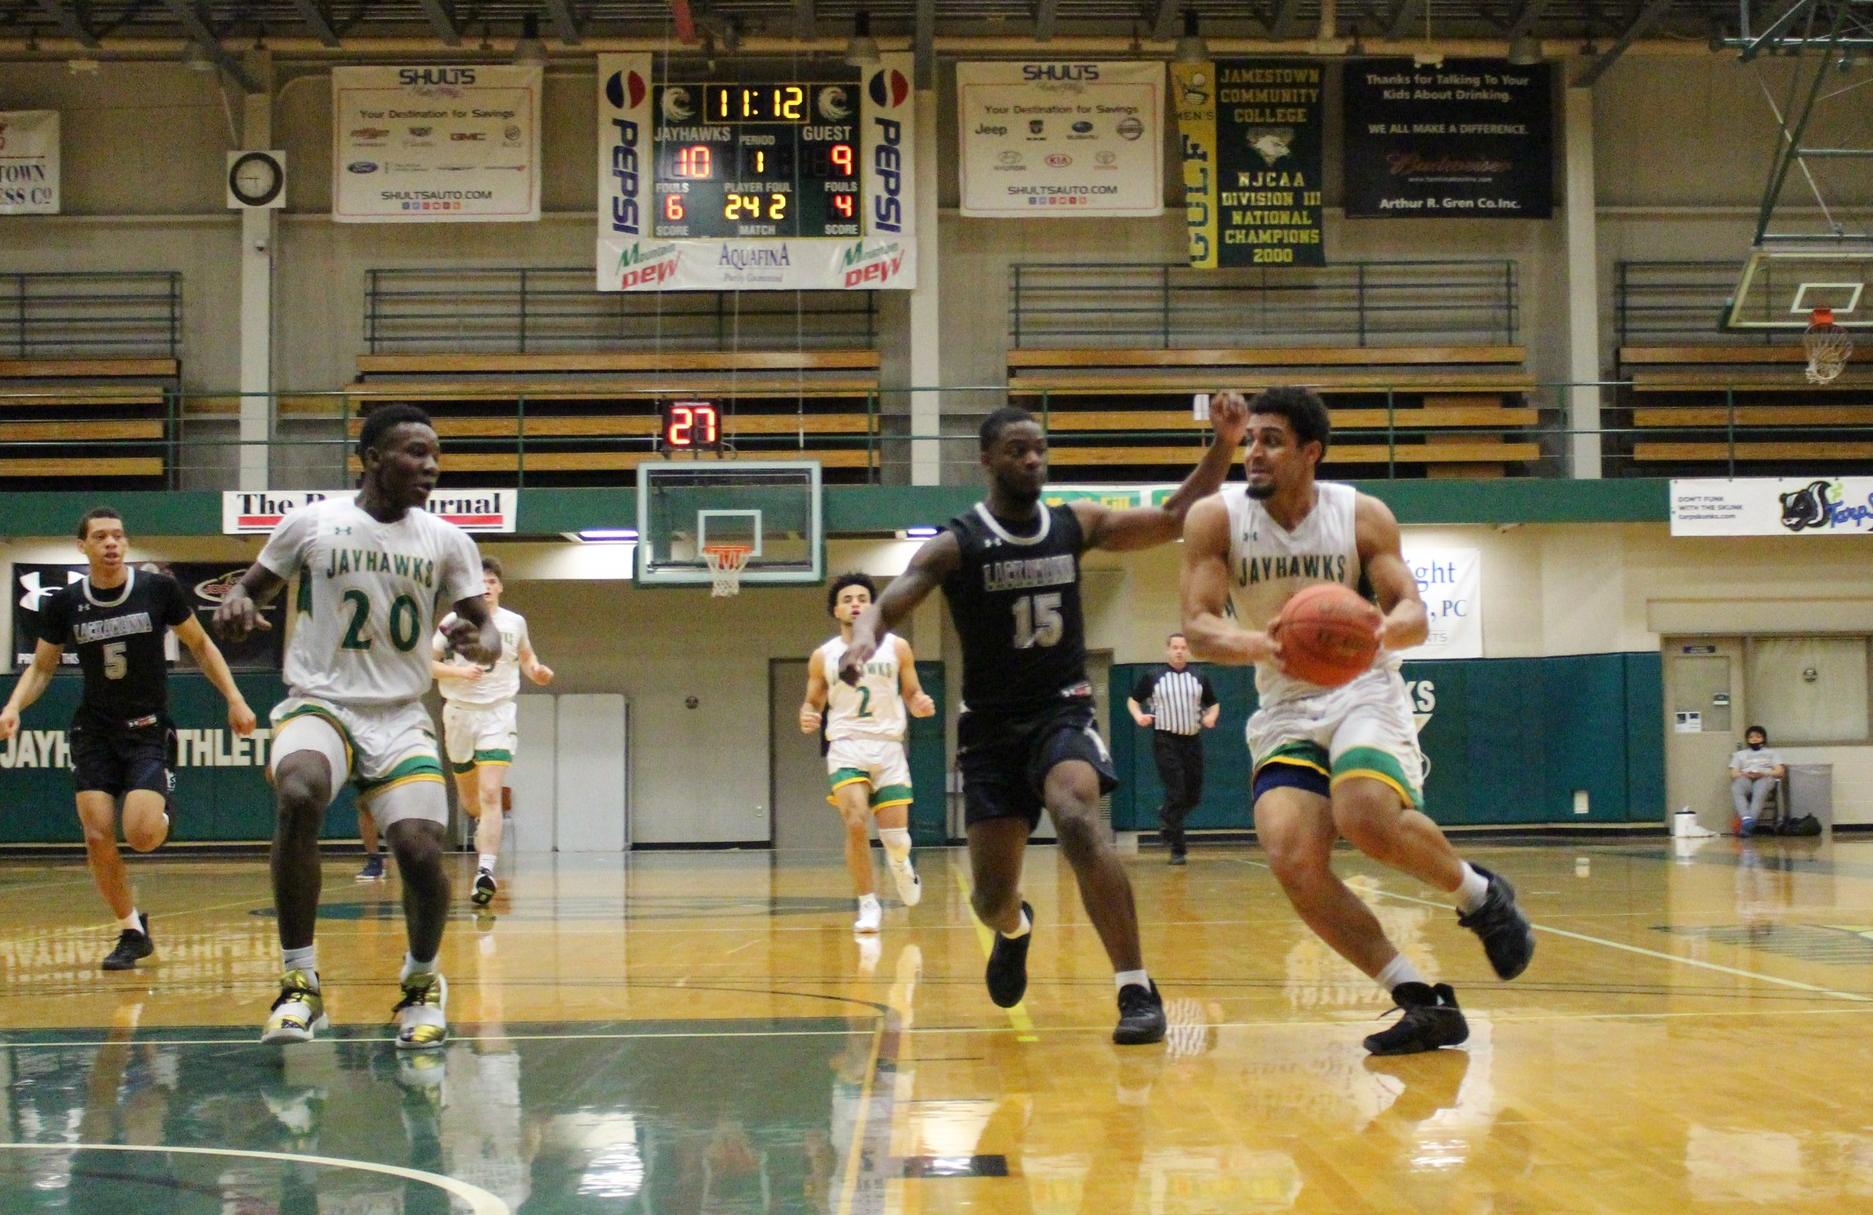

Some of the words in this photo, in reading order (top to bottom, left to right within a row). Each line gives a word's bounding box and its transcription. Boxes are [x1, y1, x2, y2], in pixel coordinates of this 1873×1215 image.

[399, 69, 476, 85] SHULTS
[1023, 65, 1099, 80] SHULTS
[1220, 69, 1320, 83] JAMESTOWN
[1367, 74, 1411, 84] Thanks
[1415, 75, 1432, 84] for
[1437, 74, 1480, 87] Talking
[1485, 75, 1498, 84] To
[1502, 75, 1529, 85] Your
[721, 87, 802, 118] 11:12
[1220, 89, 1320, 103] COMMUNITY
[1383, 90, 1410, 99] Kids
[1414, 90, 1451, 99] About
[1456, 90, 1512, 102] Drinking.
[360, 110, 384, 119] Your
[389, 110, 448, 119] Destination
[452, 110, 467, 119] for
[472, 109, 515, 120] Savings
[985, 105, 1009, 114] Your
[1013, 105, 1072, 114] Destination
[1076, 105, 1092, 114] for
[1096, 105, 1139, 115] Savings
[1234, 109, 1307, 123] COLLEGE
[654, 127, 731, 142] JAYHAWKS
[803, 126, 852, 141] GUEST
[975, 123, 1008, 136] Jeep
[1368, 124, 1386, 134] WE
[1389, 124, 1409, 134] ALL
[1413, 124, 1445, 134] MAKE
[1449, 124, 1457, 134] A
[1460, 124, 1528, 134] DIFFERENCE.
[450, 132, 487, 142] GMC
[739, 135, 776, 145] PERIOD
[679, 145, 711, 178] 10
[756, 151, 764, 173] 1
[831, 145, 853, 176] 9
[1050, 156, 1068, 165] KIA
[612, 118, 639, 235] PEPSI
[874, 117, 901, 233] PEPSI
[1238, 172, 1305, 187] NJCAA
[656, 182, 689, 193] FOULS
[724, 182, 763, 192] PLAYER
[766, 182, 792, 192] FOUL
[824, 182, 858, 192] FOULS
[1008, 186, 1118, 196] SHULTSAUTO.COM
[381, 191, 492, 200] SHULTSAUTO.COM
[1182, 134, 1209, 262] GOLF
[1222, 192, 1293, 206] DIVISION
[1304, 192, 1321, 206] III
[665, 194, 684, 220] 6
[725, 194, 760, 220] 24
[769, 194, 786, 220] 2
[836, 195, 852, 218] 4
[1380, 199, 1424, 209] Arthur
[1427, 199, 1440, 209] R.
[1443, 199, 1474, 209] Gren
[1232, 211, 1312, 225] NATIONAL
[656, 225, 689, 236] SCORE
[738, 225, 776, 235] MATCH
[825, 225, 858, 235] SCORE
[1225, 229, 1320, 244] CHAMPIONS
[719, 242, 790, 270] AQUAFINA
[1253, 248, 1293, 263] 2000
[670, 408, 715, 444] 27
[238, 494, 293, 514] The
[327, 549, 433, 588] JAYHAWKS
[1239, 555, 1346, 587] JAYHAWKS
[1405, 560, 1456, 592] ght
[1443, 601, 1467, 617] PC
[342, 590, 421, 651] 20
[1012, 592, 1064, 649] 15
[104, 642, 127, 680] 5
[856, 686, 873, 717] 2
